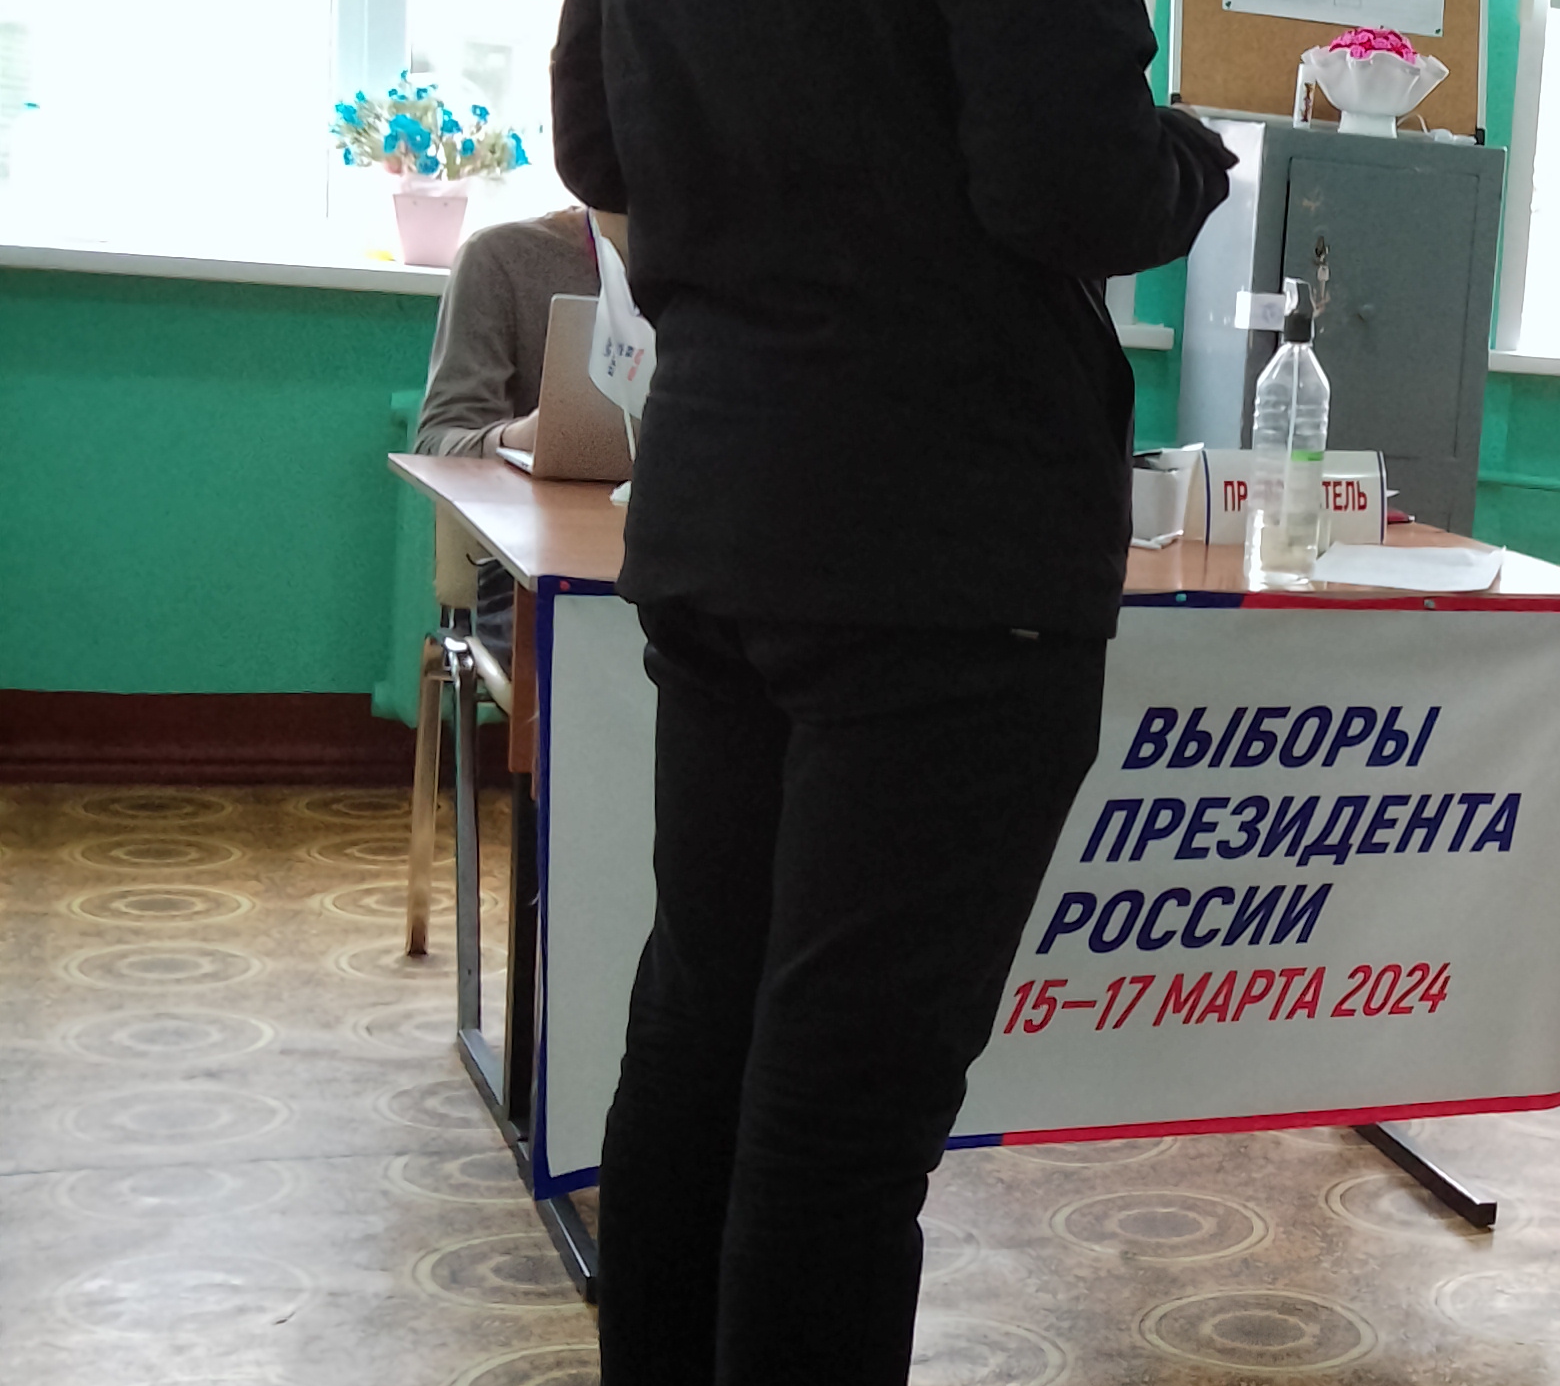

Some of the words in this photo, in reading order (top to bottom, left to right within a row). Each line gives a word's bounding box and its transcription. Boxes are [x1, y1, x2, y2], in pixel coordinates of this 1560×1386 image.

[1223, 480, 1368, 512] ПРТЕЛЬ
[1121, 706, 1442, 770] ВЫБОРЫ
[1079, 792, 1522, 867] ПРЕЗИДЕНТА
[1035, 883, 1333, 954] РОССИИ
[1152, 966, 1328, 1027] МАРТА
[1330, 962, 1452, 1018] 2024
